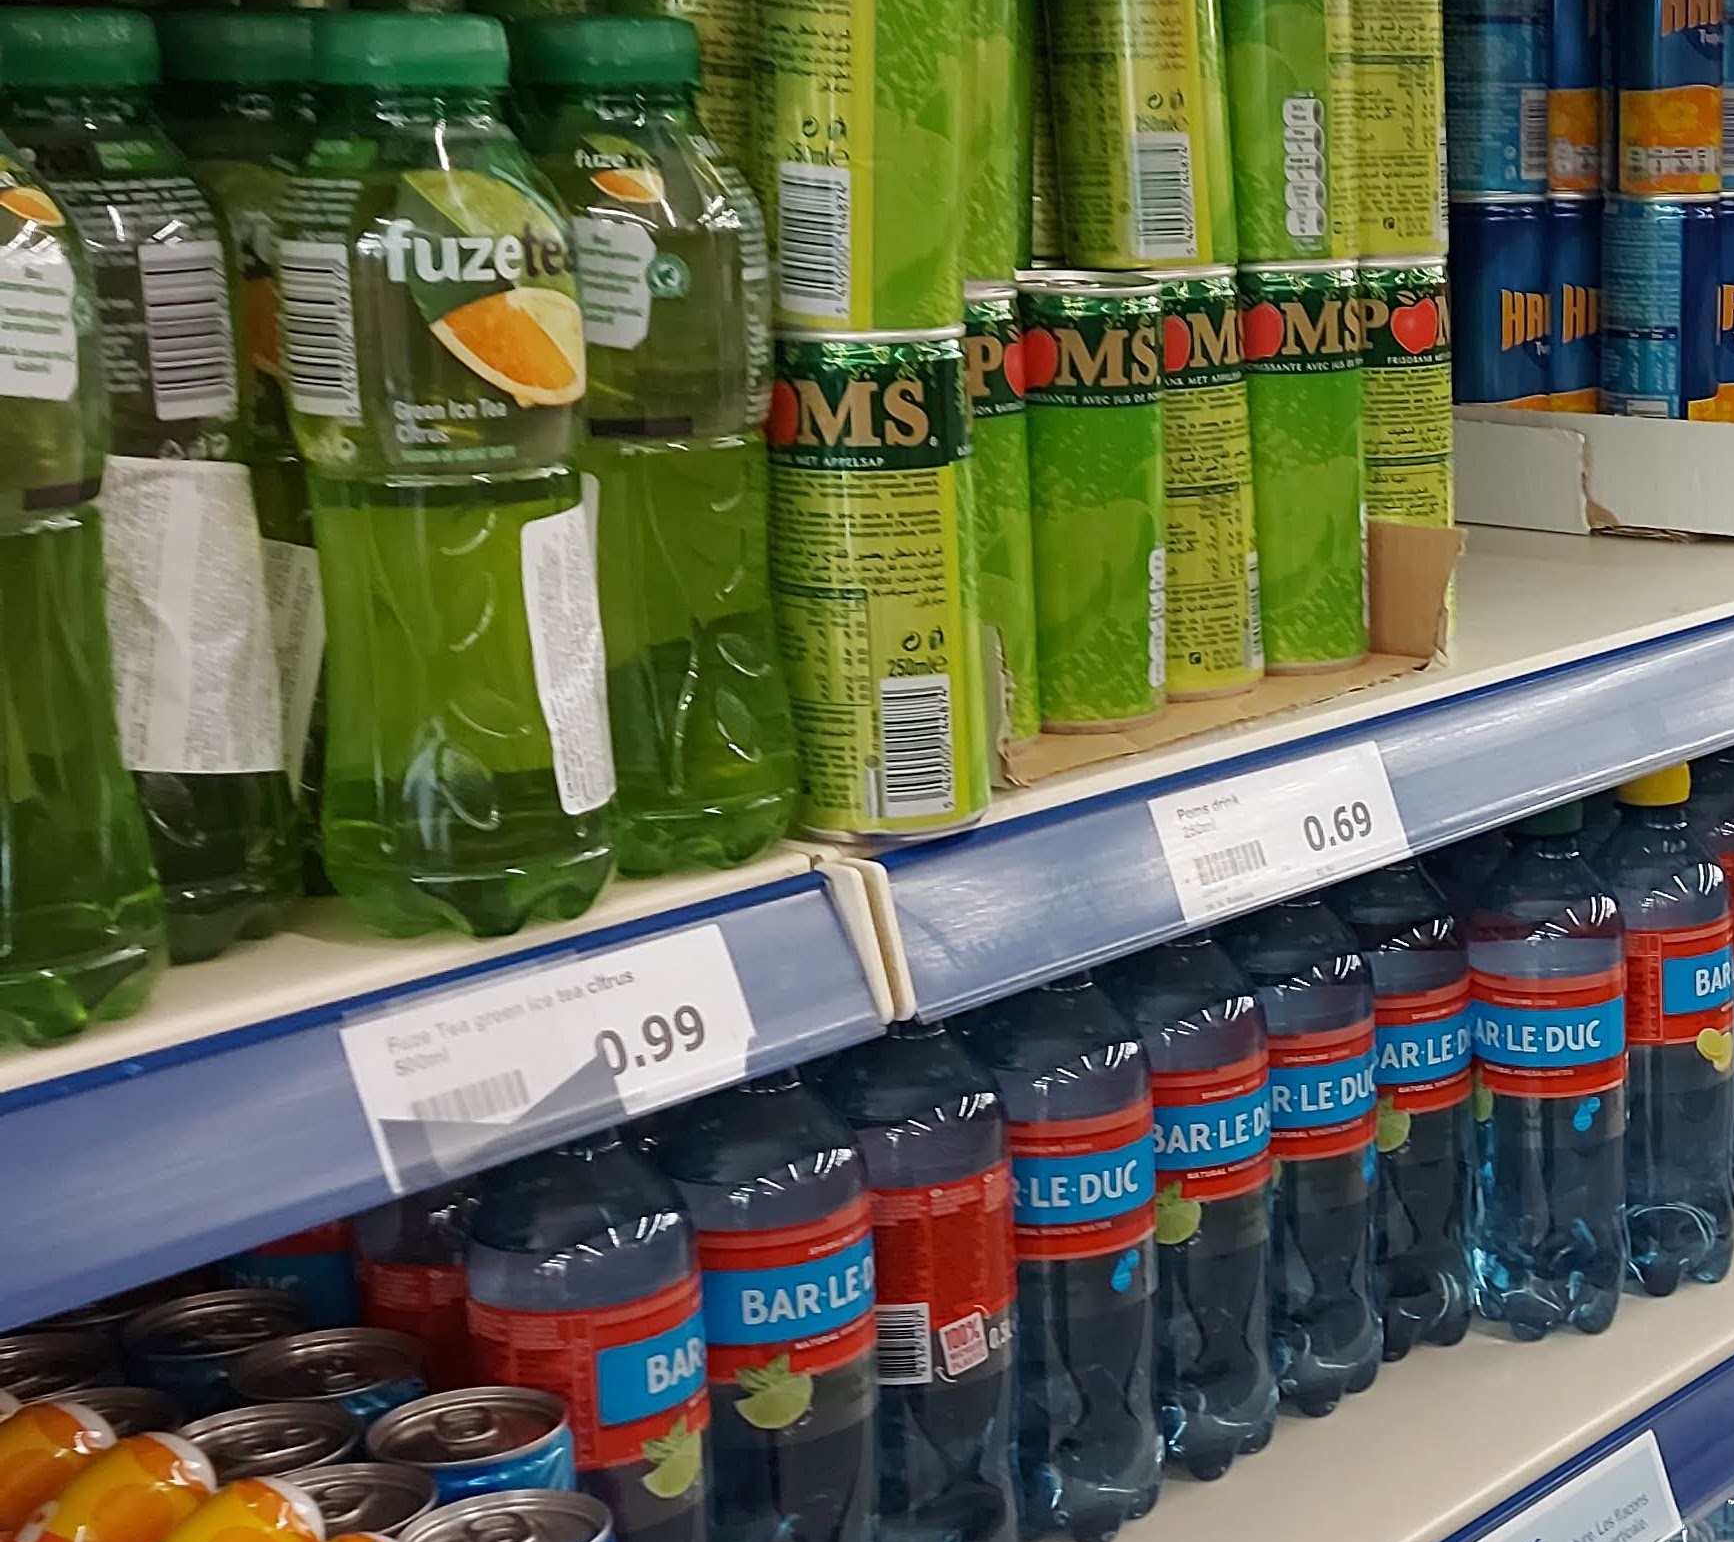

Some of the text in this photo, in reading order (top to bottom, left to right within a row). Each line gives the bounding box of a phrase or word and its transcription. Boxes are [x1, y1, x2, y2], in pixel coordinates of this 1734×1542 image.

[386, 218, 572, 282] fuzete
[1303, 801, 1372, 853] 0.69
[474, 1003, 526, 1032] green
[528, 990, 555, 1015] ice
[557, 983, 584, 1005] tea
[587, 970, 635, 995] citrus
[595, 1005, 706, 1077] 0.99
